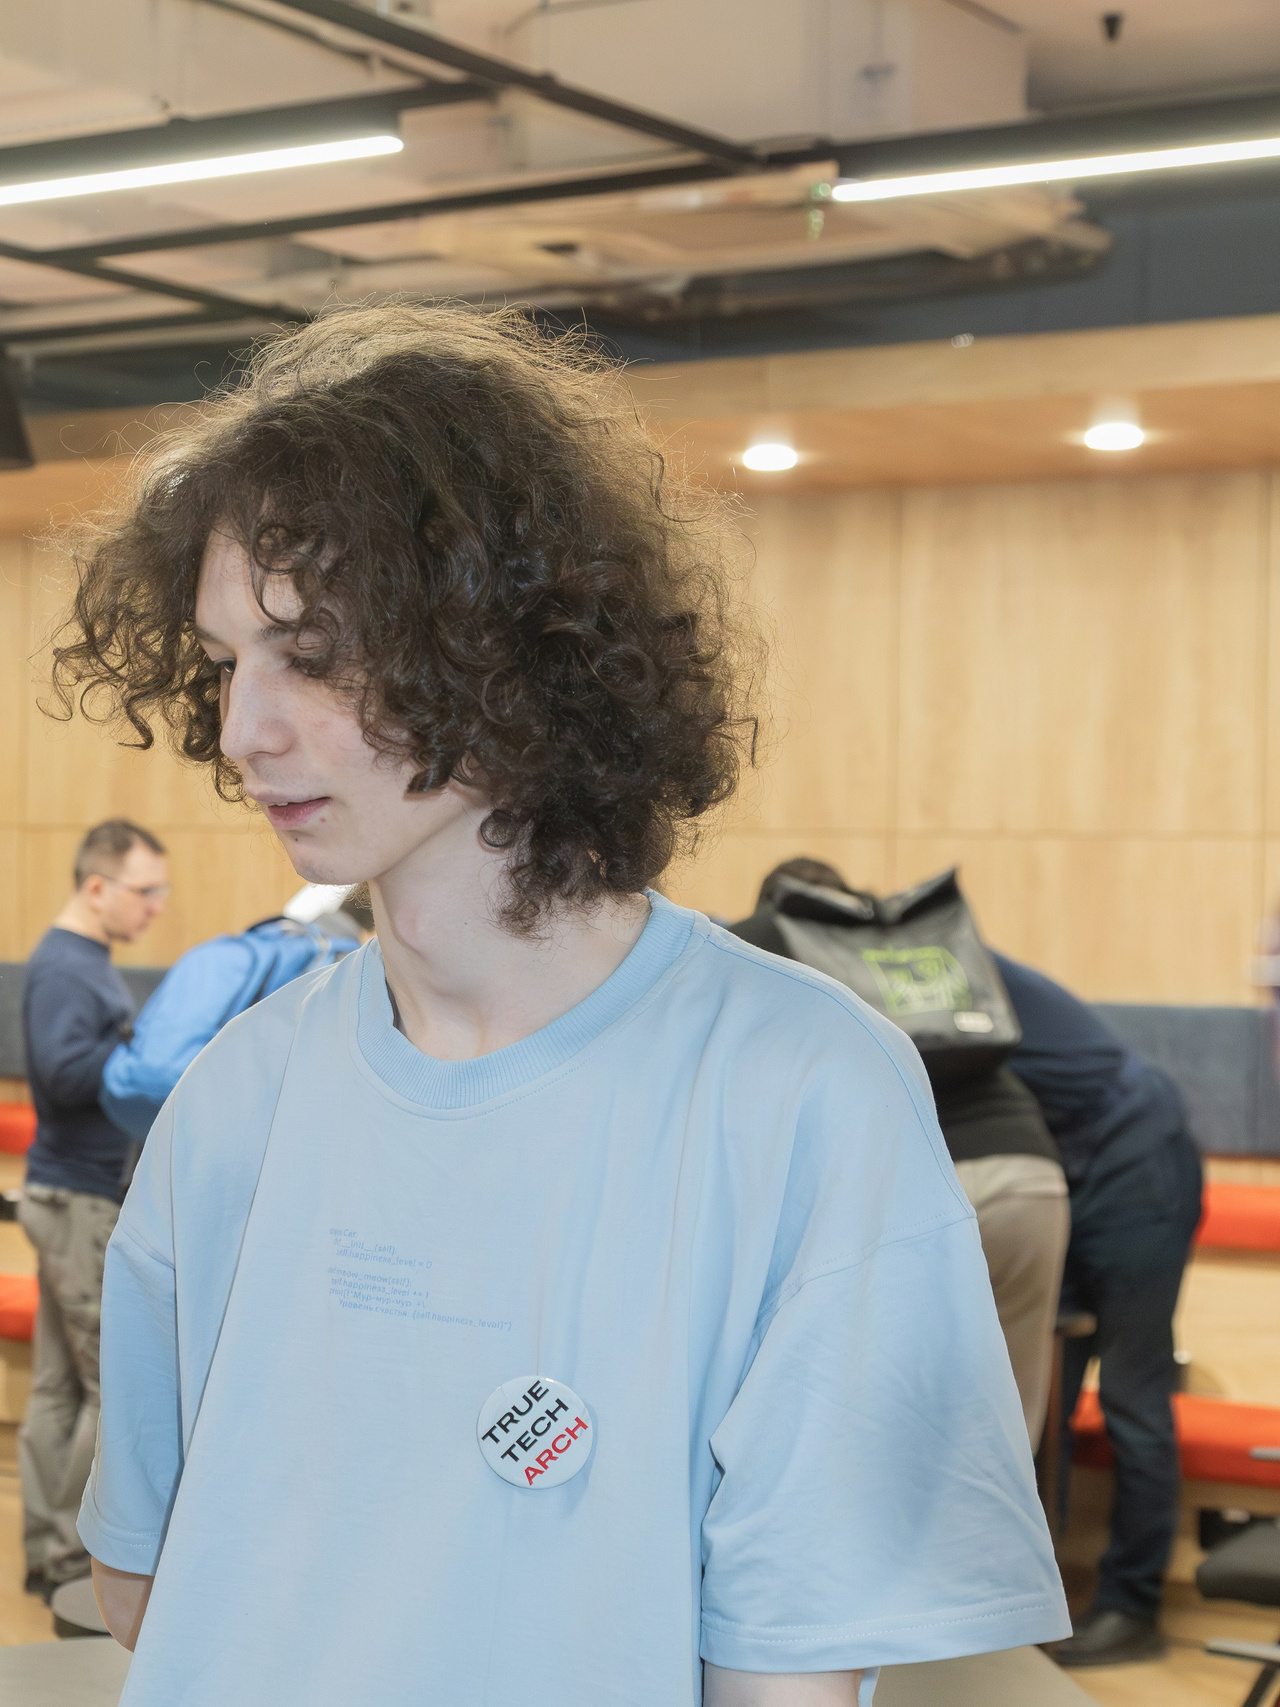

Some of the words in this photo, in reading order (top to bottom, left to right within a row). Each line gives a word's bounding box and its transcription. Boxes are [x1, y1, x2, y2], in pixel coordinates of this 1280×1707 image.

[481, 1380, 550, 1444] TRUE
[500, 1398, 570, 1463] TECH
[524, 1416, 589, 1486] ARCH
